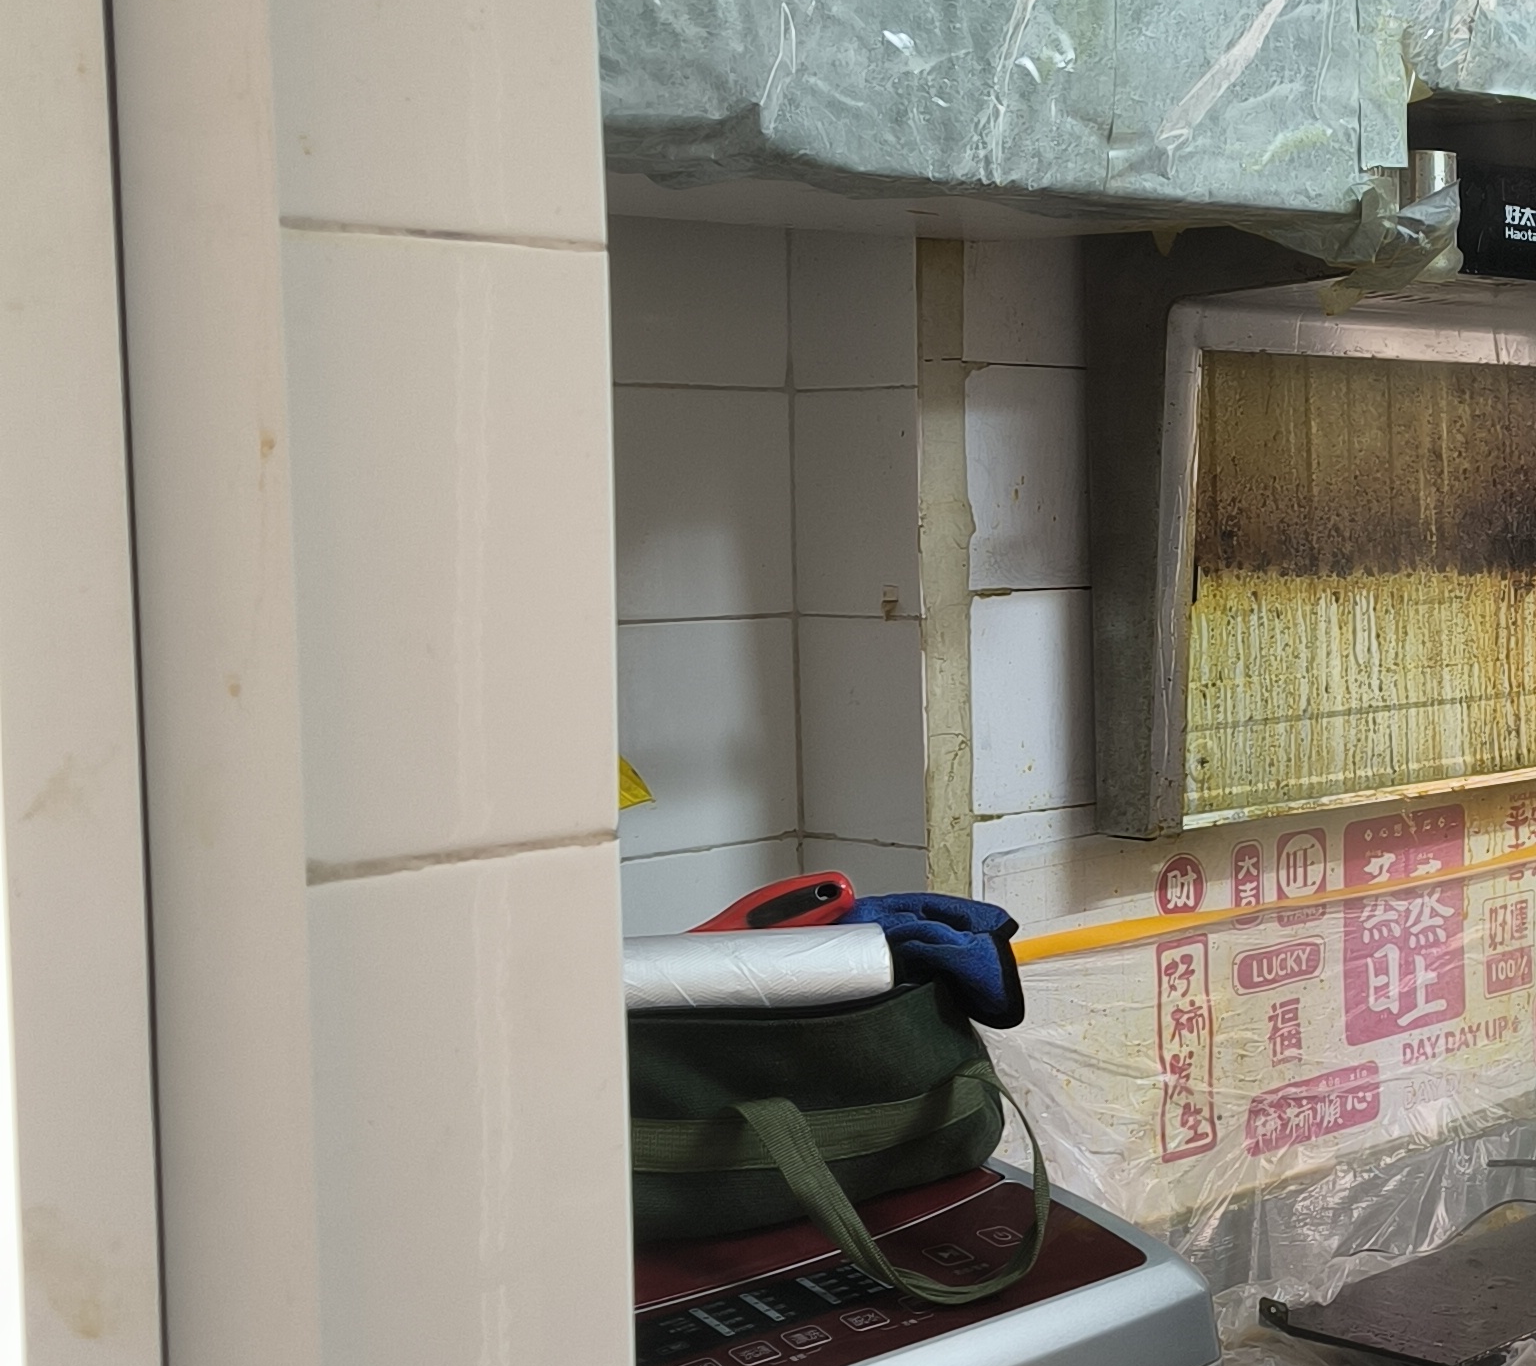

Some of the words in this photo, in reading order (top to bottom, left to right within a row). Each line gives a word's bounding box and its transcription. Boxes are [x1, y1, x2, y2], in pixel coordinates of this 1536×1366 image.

[1166, 865, 1197, 910] 财
[1237, 855, 1258, 908] 大吉
[1285, 843, 1317, 890] 旺
[1488, 898, 1529, 952] 好運
[1251, 947, 1311, 983] LUCKY
[1491, 955, 1529, 982] 100%
[1267, 997, 1303, 1065] 福
[1402, 1033, 1441, 1065] DAY
[1444, 1021, 1482, 1055] DAY
[1484, 1015, 1509, 1043] UP
